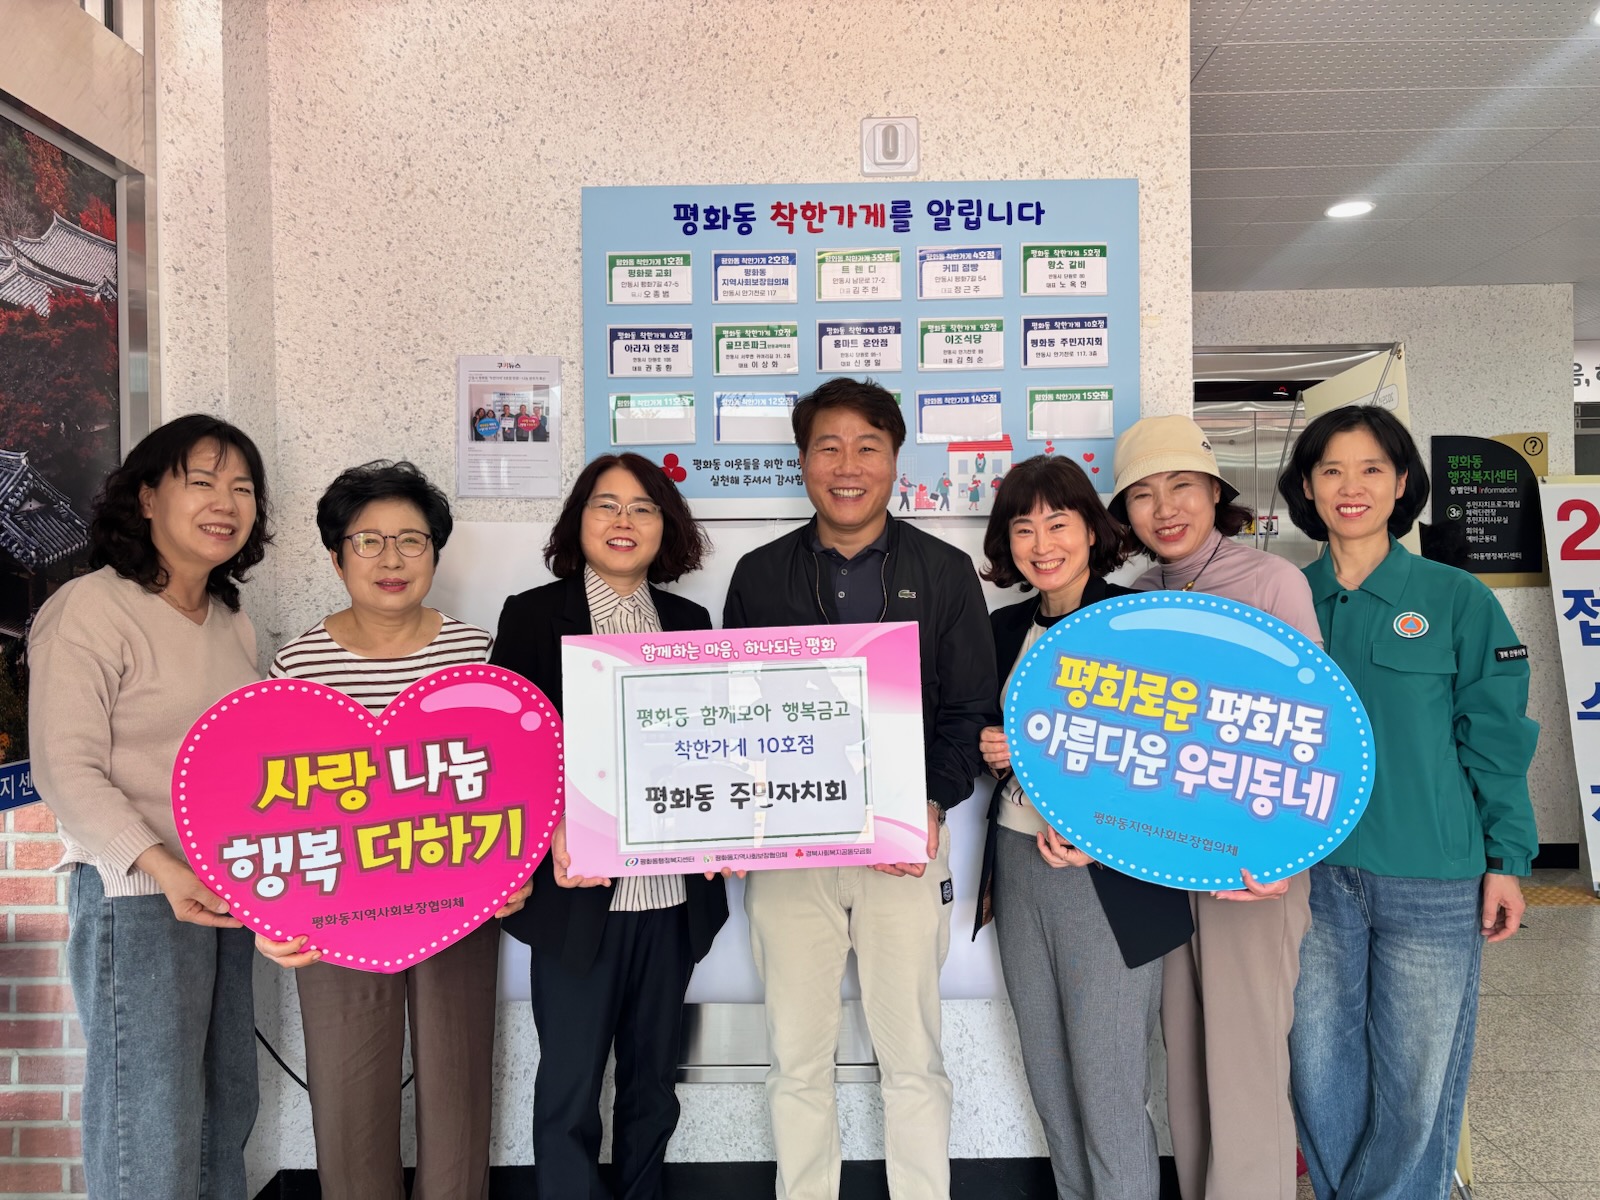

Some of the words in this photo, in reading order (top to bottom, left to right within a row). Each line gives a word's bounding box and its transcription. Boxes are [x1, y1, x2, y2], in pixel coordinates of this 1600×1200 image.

[673, 203, 757, 236] 평화동
[770, 199, 913, 235] 착한가게를
[926, 198, 1046, 231] 알립니다
[943, 264, 959, 272] 커피
[1069, 260, 1086, 269] 갈비
[628, 269, 652, 278] 평화로
[655, 269, 672, 277] 교회
[1084, 320, 1104, 328] 10호점
[863, 339, 888, 347] 운안점
[945, 334, 982, 344] 이조식당
[1031, 338, 1055, 347] 평화동
[654, 344, 679, 352] 안동점
[692, 459, 721, 471] 평화동
[724, 459, 760, 470] 이웃들을
[764, 459, 784, 469] 위한
[1448, 455, 1483, 469] 평화동
[710, 475, 740, 486] 실천해
[1448, 470, 1518, 485] 행정복지센터
[1450, 508, 1460, 517] 3F
[641, 642, 700, 662] 함께하는
[705, 640, 739, 659] 마음,
[744, 637, 802, 656] 하나되는
[806, 637, 836, 655] 평화
[636, 707, 689, 729] 평화동
[782, 701, 850, 722] 행복금고
[1056, 655, 1199, 732] 평화로운
[1206, 688, 1324, 764] 평화동
[757, 734, 814, 755] 10호점
[1027, 712, 1168, 787] 아름다운
[1174, 744, 1336, 821] 우리동네
[256, 751, 378, 811] 사랑
[388, 742, 489, 801] 나눔
[645, 784, 714, 814] 평화동
[1093, 811, 1239, 856] 평화동지역사회보장협의체
[222, 828, 342, 898] 행복
[357, 808, 522, 871] 더하기
[312, 897, 465, 929] 평화동지역사회보장협의체
